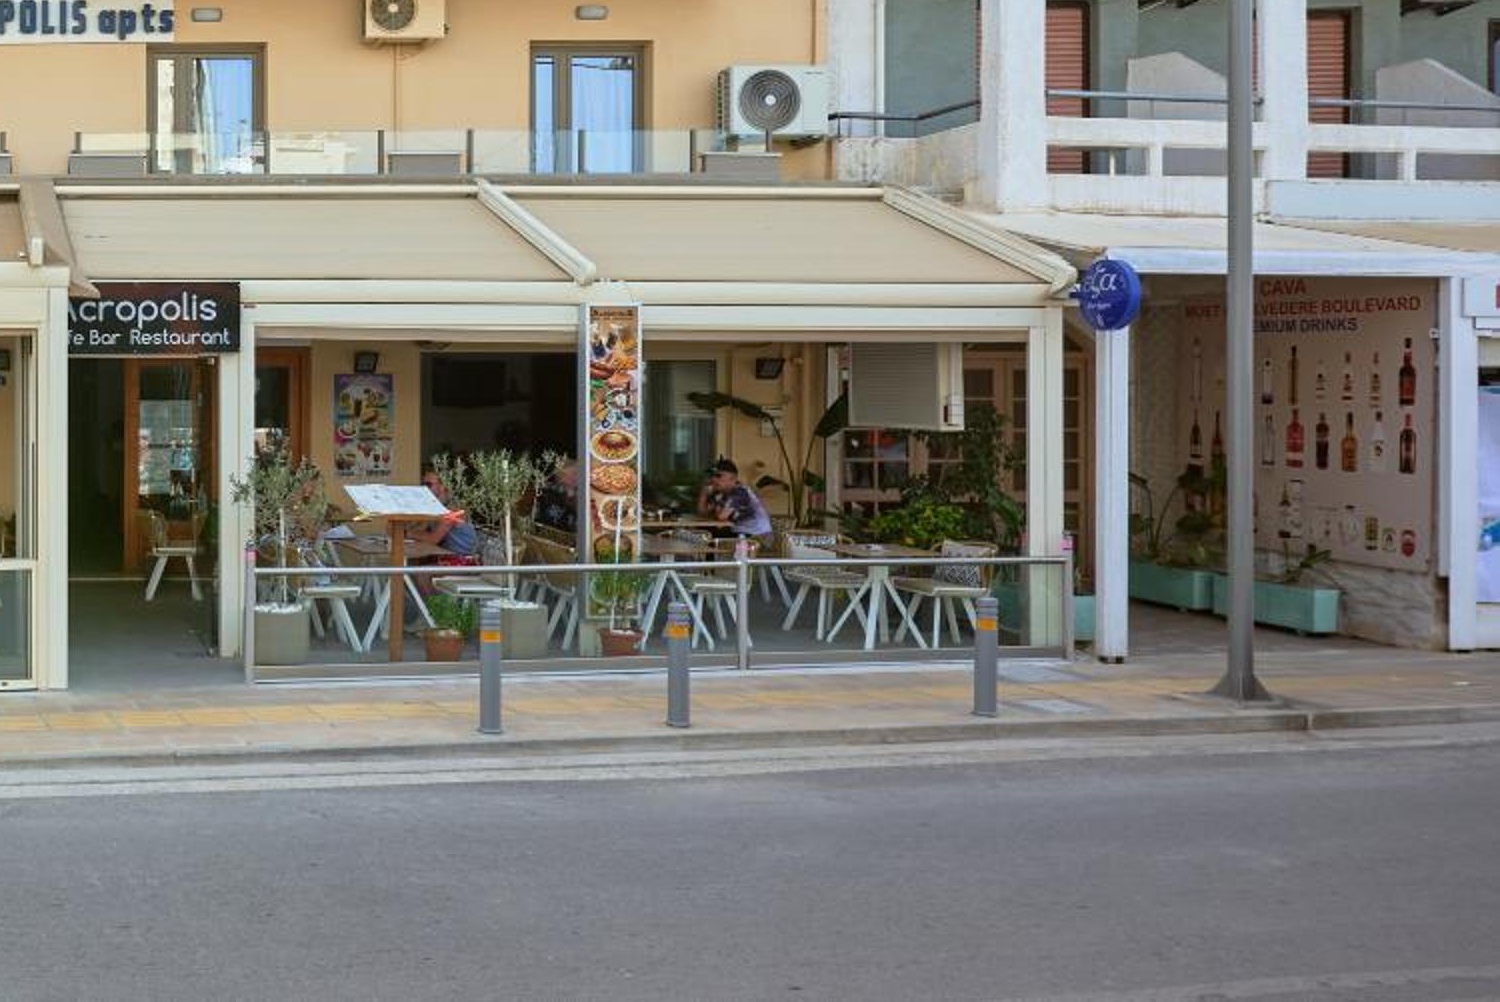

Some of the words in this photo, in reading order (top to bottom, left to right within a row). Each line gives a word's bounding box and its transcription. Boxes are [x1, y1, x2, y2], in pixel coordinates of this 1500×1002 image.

[97, 3, 175, 40] apts
[1260, 279, 1307, 297] CAVA
[1321, 296, 1421, 314] BOULEVARD
[1299, 318, 1359, 332] DRINKS
[89, 329, 122, 345] Bar
[130, 328, 231, 345] Restaurant
